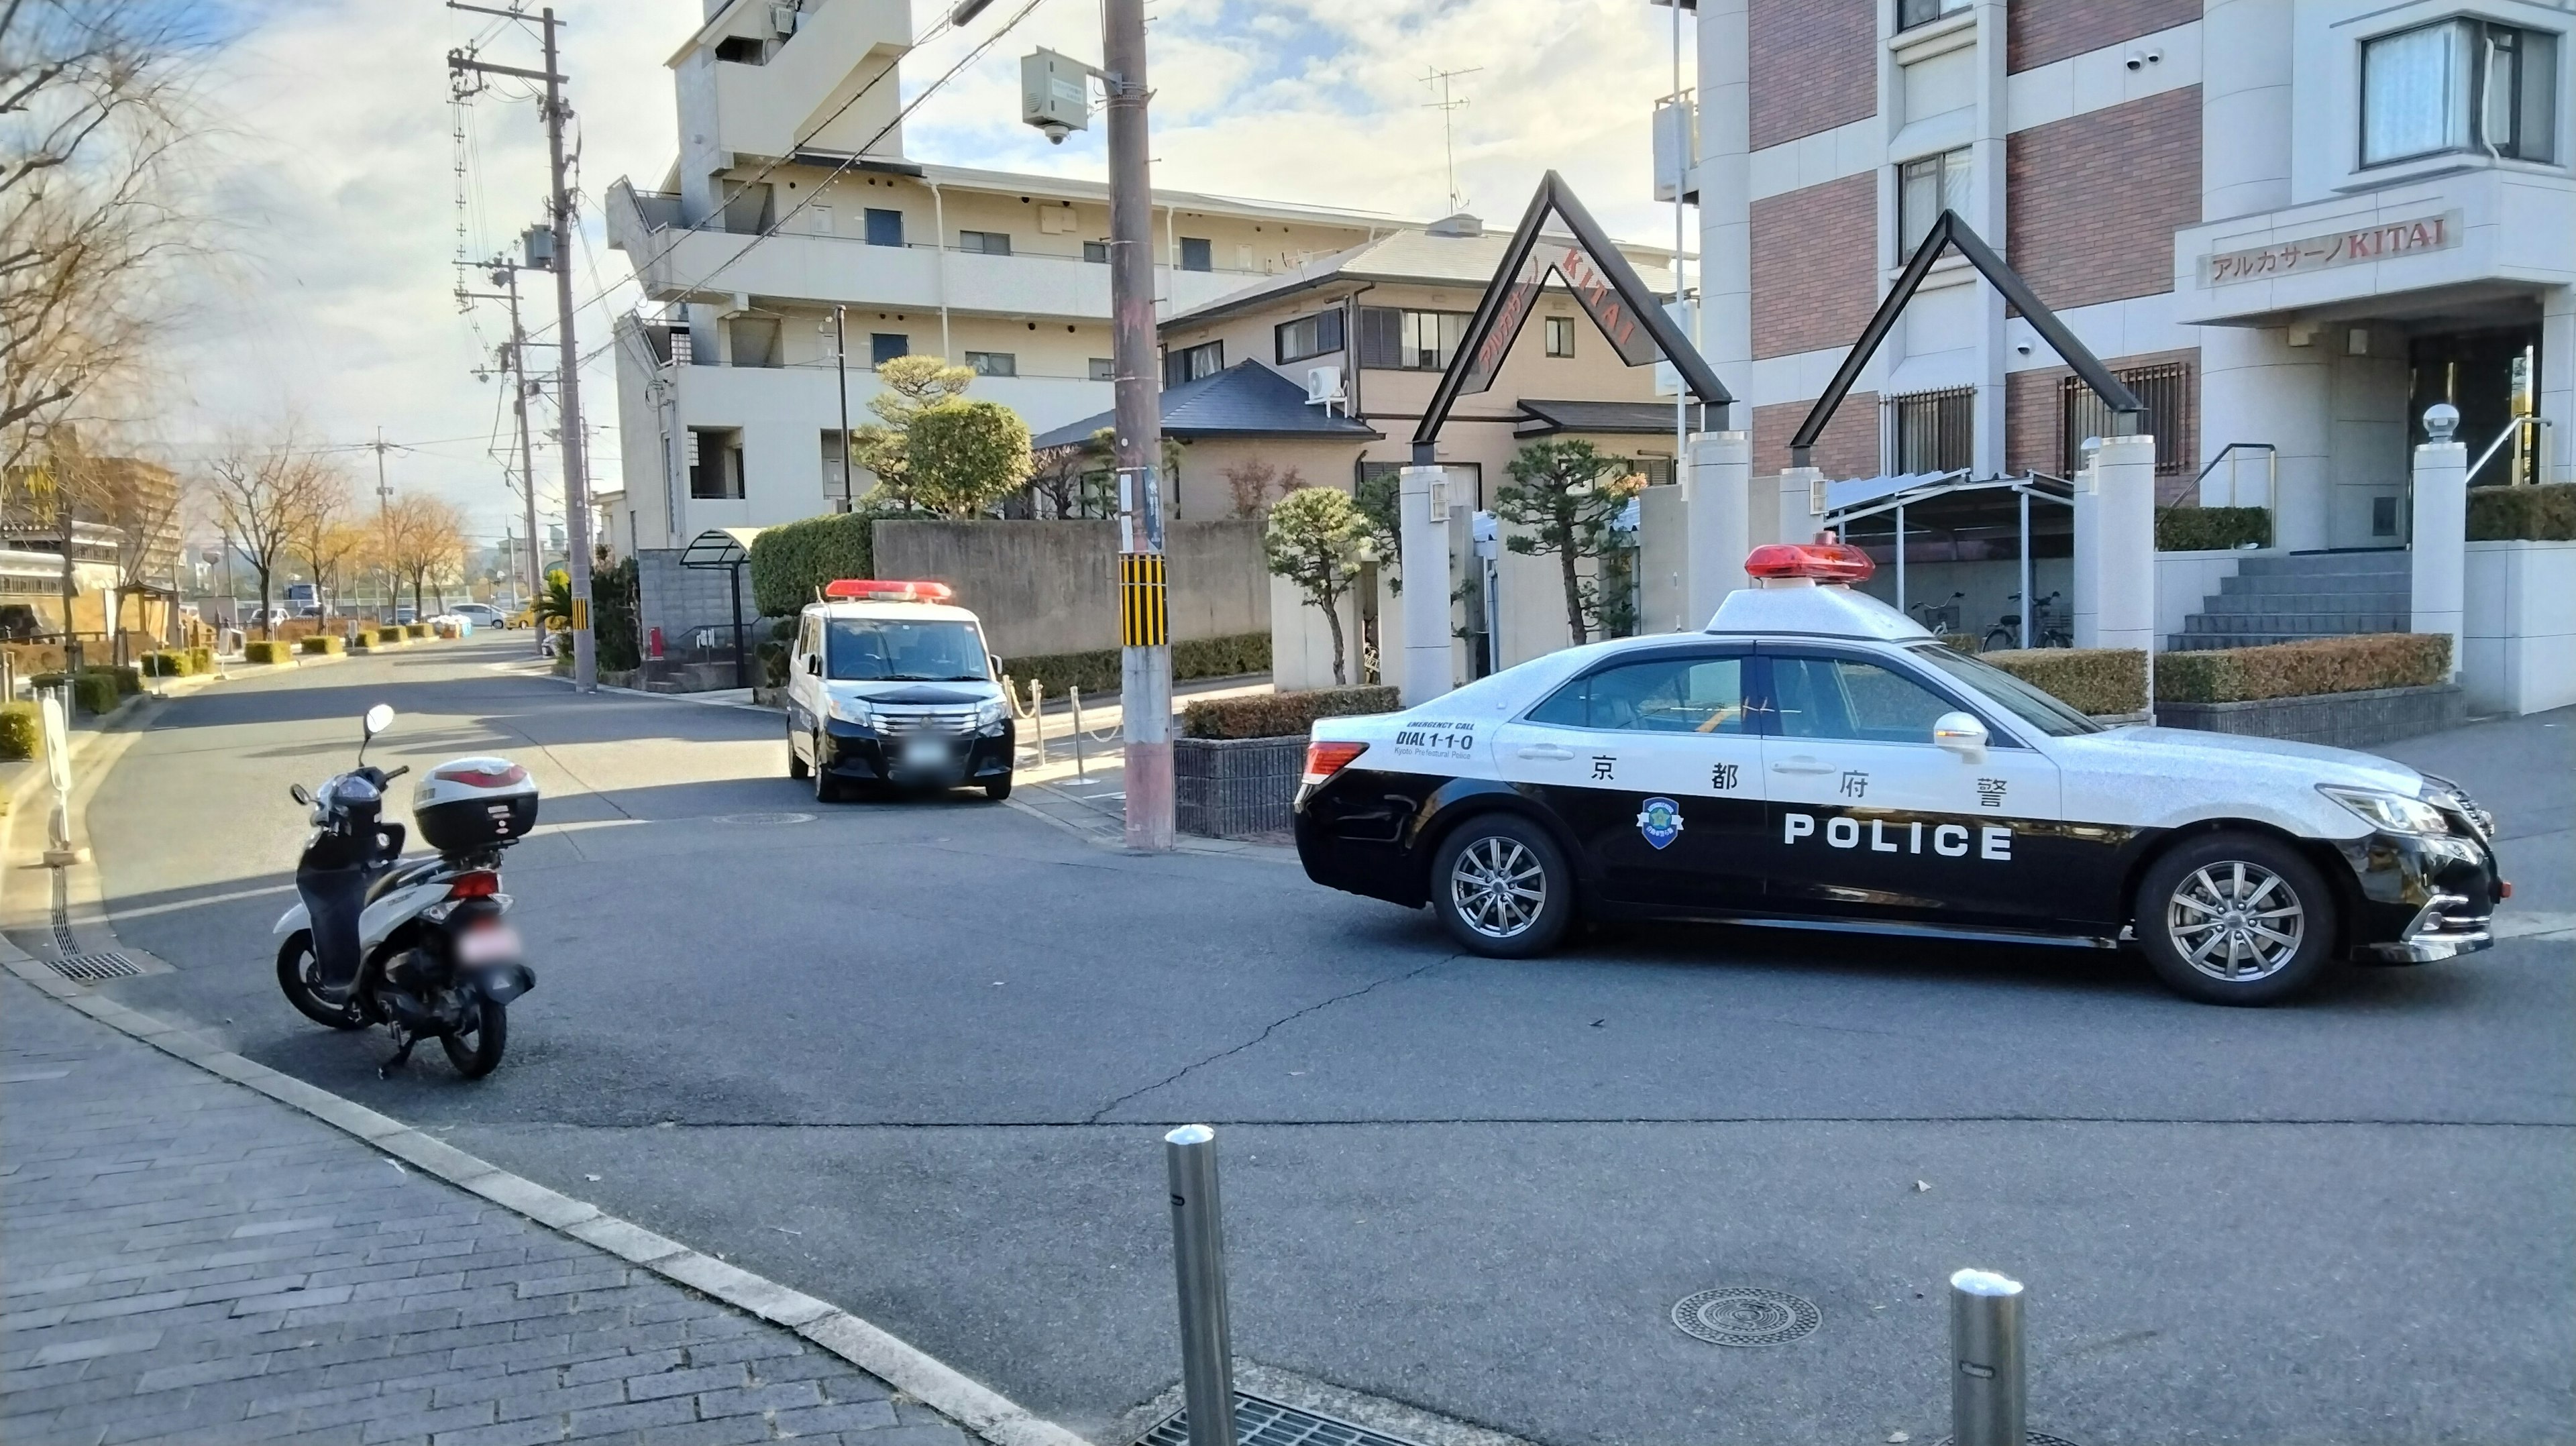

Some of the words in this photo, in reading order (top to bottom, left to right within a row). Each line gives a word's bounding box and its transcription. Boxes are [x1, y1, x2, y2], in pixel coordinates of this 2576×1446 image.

[2212, 238, 2343, 281] アルカサーノ
[2349, 219, 2445, 260] KITAI
[1562, 247, 1636, 345] KITAI
[1396, 731, 1426, 746] DIAL
[1429, 733, 1474, 750] 1-1-0
[1407, 721, 1454, 729] EMERGENCY
[1455, 722, 1475, 730] CALL
[1395, 746, 1413, 756] Kyoto
[1415, 748, 1450, 758] Prefectural
[1452, 750, 1471, 760] Police
[1591, 755, 2008, 808] 京都府警
[1784, 812, 2012, 860] POLICE
